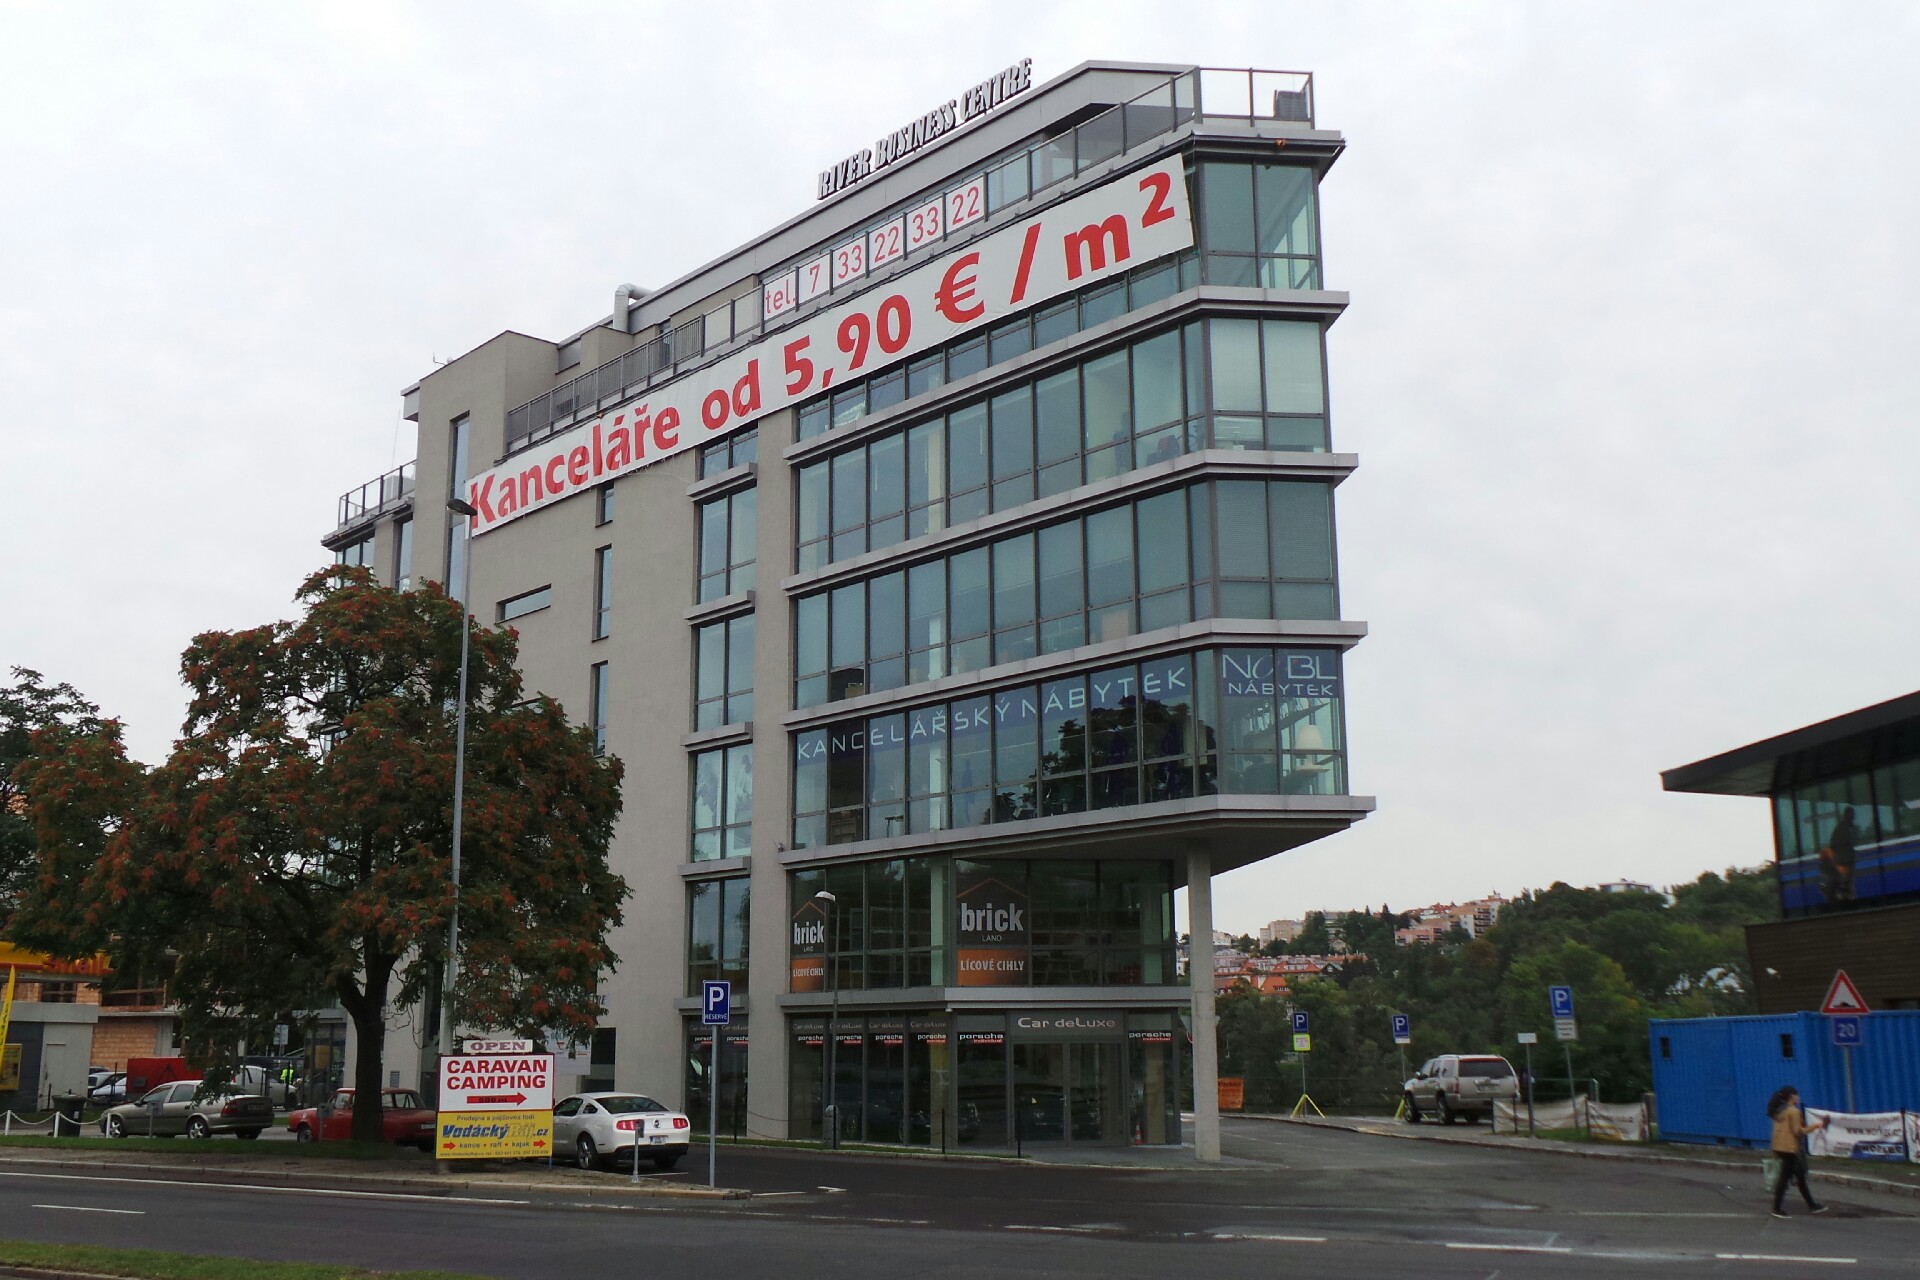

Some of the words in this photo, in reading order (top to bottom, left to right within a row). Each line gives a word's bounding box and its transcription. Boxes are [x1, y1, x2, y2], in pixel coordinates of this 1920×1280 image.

[817, 148, 871, 200] RIVER
[874, 99, 957, 170] BUSINESS
[959, 57, 1032, 121] CENTRE
[766, 279, 797, 314] tel.
[809, 263, 821, 294] 7
[837, 244, 862, 279] 33
[874, 225, 899, 263] 22
[912, 206, 939, 244] 33
[952, 186, 980, 225] 22
[469, 403, 681, 531] Kanceláře
[701, 359, 761, 431] od
[783, 294, 912, 397] 5,90
[934, 251, 986, 325] €
[1228, 680, 1334, 696] NÁBYTEK
[798, 695, 1010, 761] KANCELÁŘSKÝ
[1022, 666, 1186, 719] NÁBYTEK
[961, 902, 1024, 932] brick
[793, 920, 824, 945] brick
[982, 934, 1002, 942] LAND
[960, 958, 994, 971] LÍCOVÉ
[996, 960, 1024, 971] CIHLY
[709, 986, 725, 1011] P
[1554, 990, 1568, 1008] P
[1017, 1017, 1049, 1028] Car
[1054, 1016, 1116, 1028] deLuxe
[1295, 1014, 1305, 1028] P
[1395, 1017, 1406, 1031] P
[959, 1032, 1004, 1040] porsche
[1128, 1031, 1172, 1039] porsche
[470, 1041, 526, 1051] OPEN
[447, 1059, 547, 1074] CARAVAN
[447, 1074, 546, 1090] CAMPING
